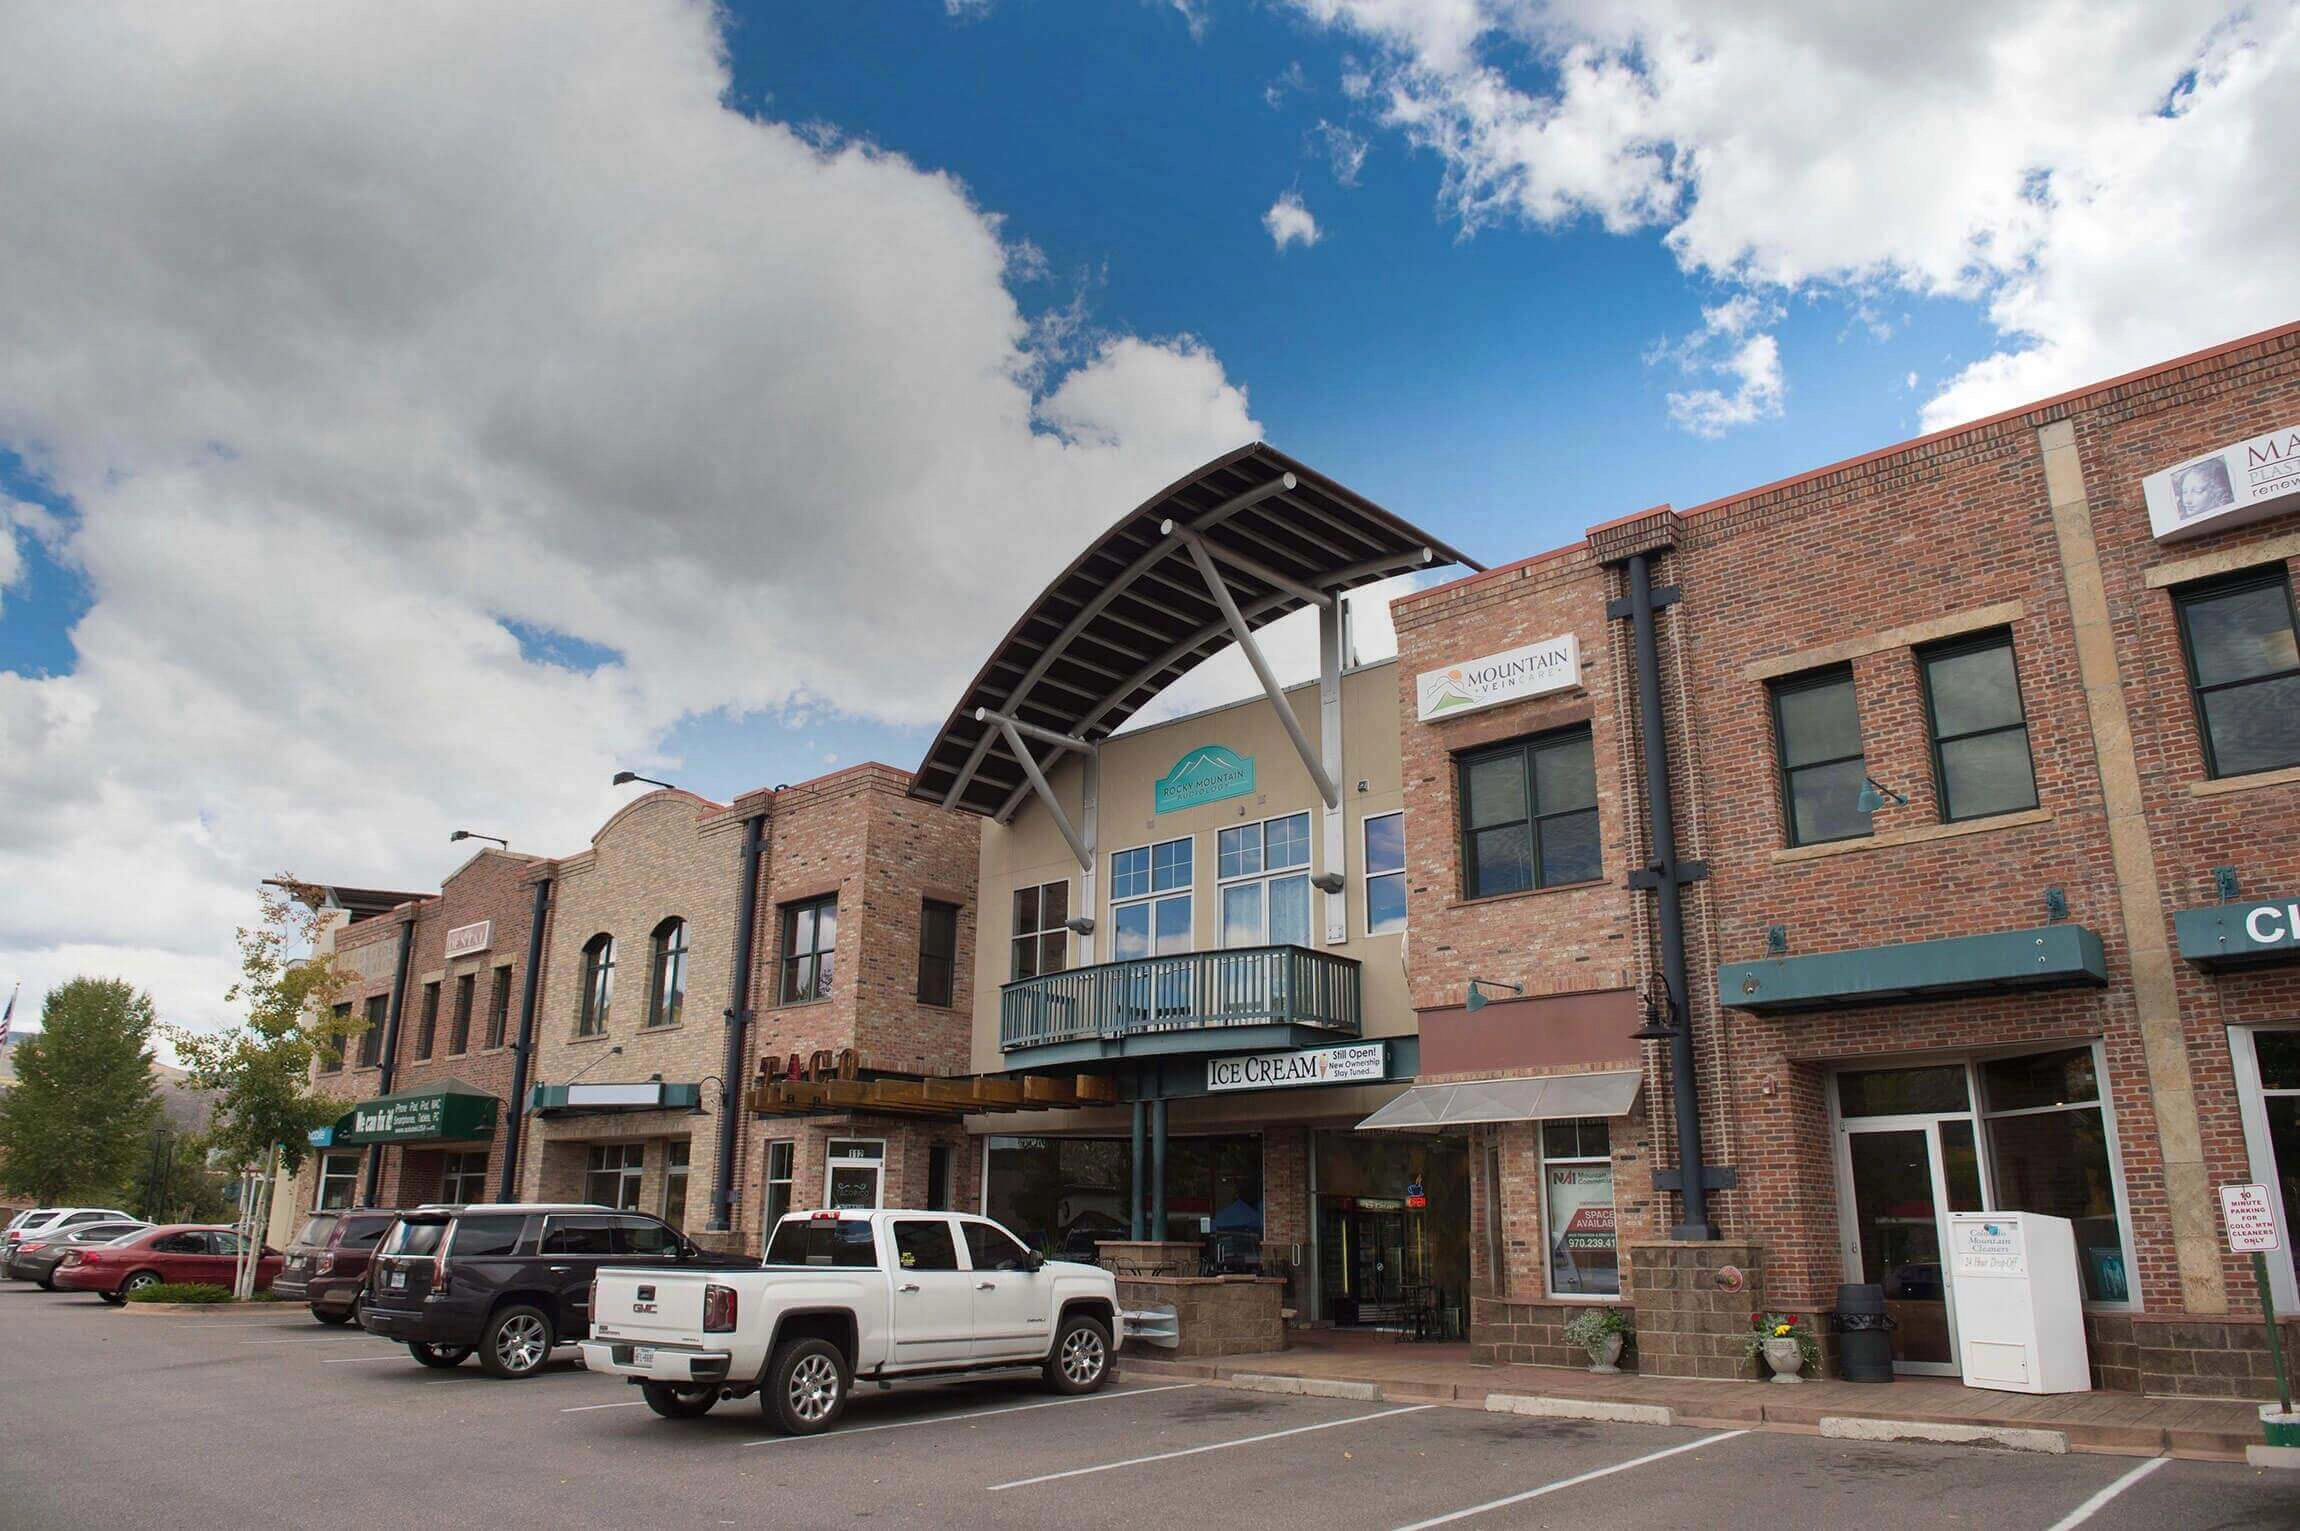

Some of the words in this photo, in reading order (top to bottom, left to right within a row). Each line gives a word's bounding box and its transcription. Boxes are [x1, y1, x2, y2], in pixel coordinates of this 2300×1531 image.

[1467, 648, 1568, 688] MOUNTAIN
[1163, 782, 1193, 797] ROCKY
[1196, 769, 1244, 788] MOUNTAIN
[1333, 1050, 1347, 1060] Still
[1349, 1047, 1377, 1059] Open!
[759, 1048, 860, 1087] TACO
[1329, 1062, 1344, 1070] New
[1345, 1058, 1381, 1070] Ownership
[1210, 1059, 1241, 1085] ICE
[1245, 1056, 1317, 1085] CREAM
[1334, 1069, 1349, 1079] Stay
[1553, 1170, 1576, 1185] NAI
[1584, 1210, 1615, 1219] SPACE
[1576, 1219, 1615, 1228] AVAILAB
[1568, 1238, 1616, 1249] 970.239.41
[1969, 1236, 2012, 1245] Mountain
[1972, 1245, 2009, 1253] Cleaners
[632, 1303, 658, 1314] GMC
